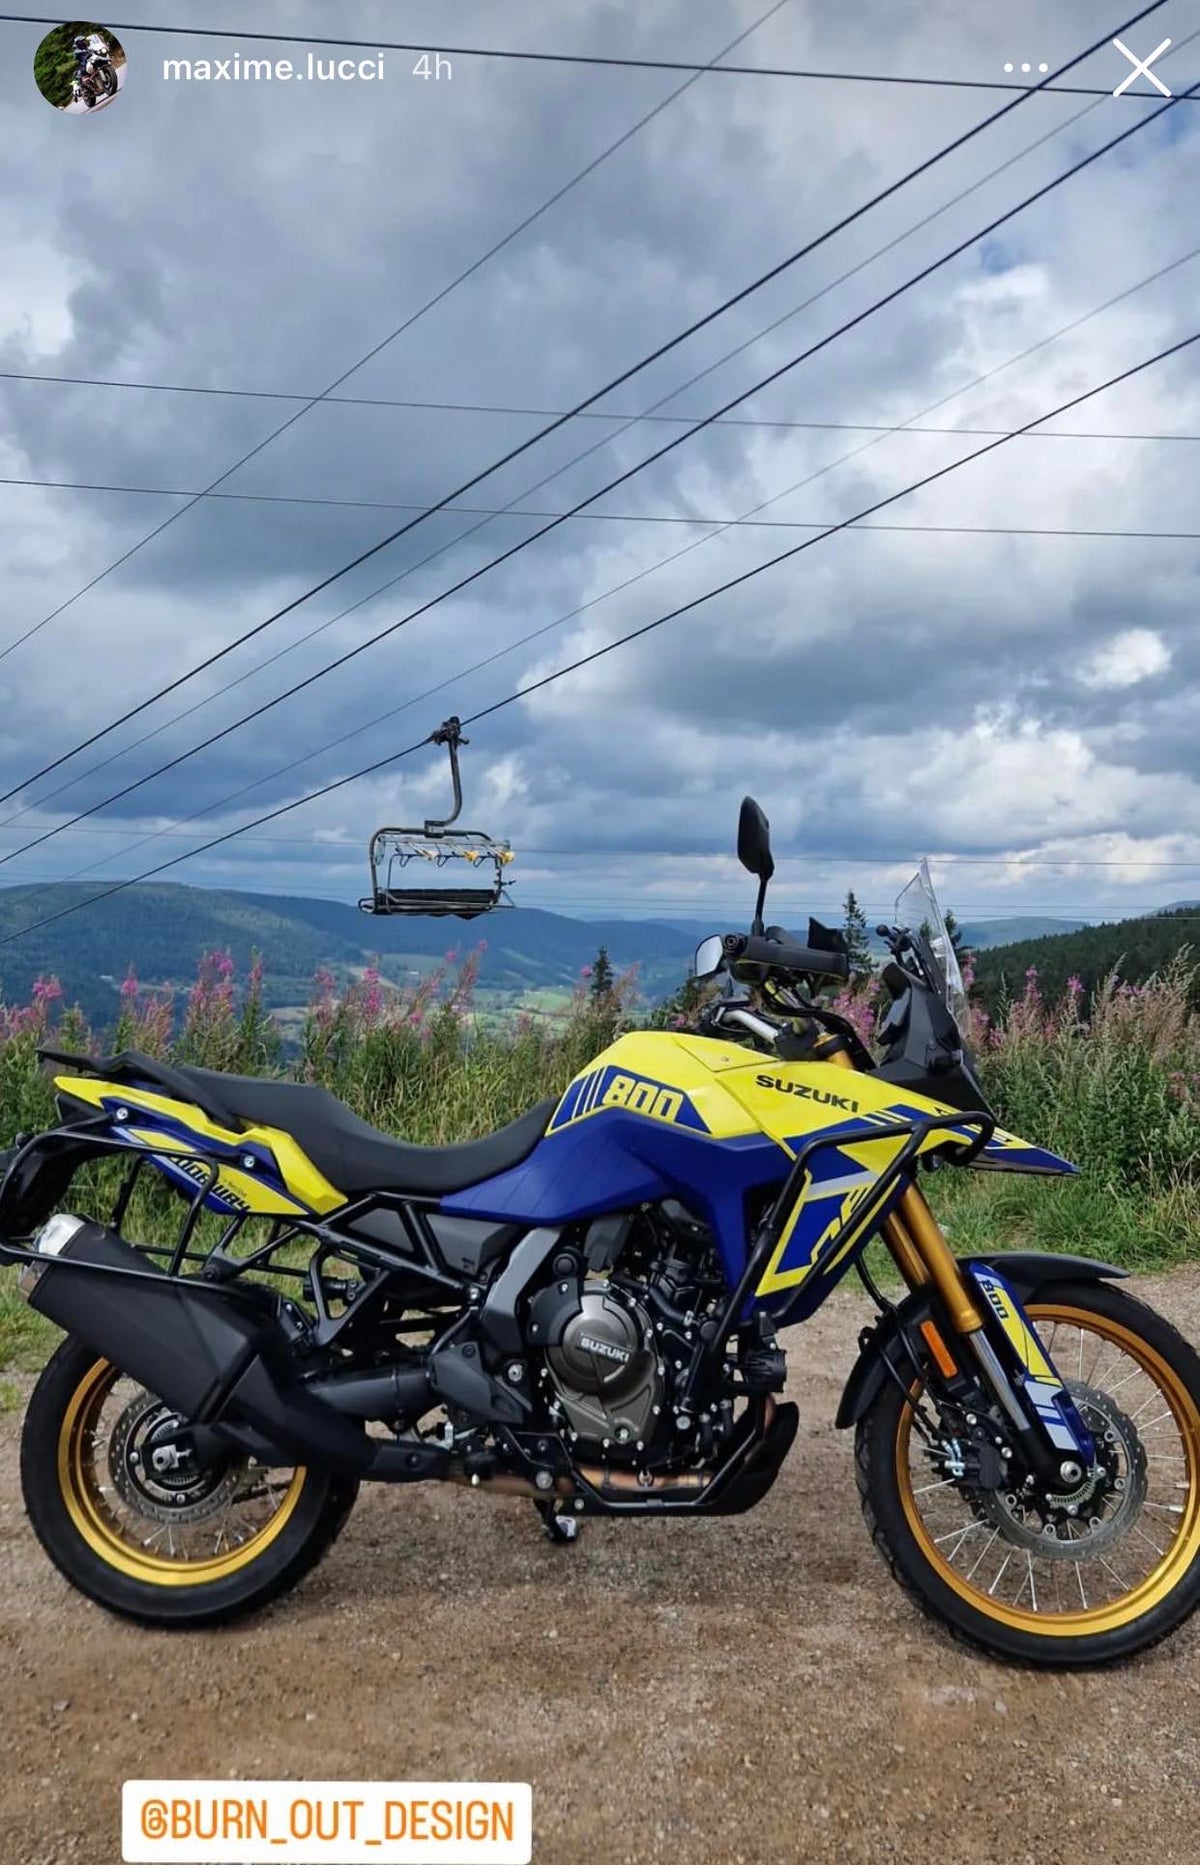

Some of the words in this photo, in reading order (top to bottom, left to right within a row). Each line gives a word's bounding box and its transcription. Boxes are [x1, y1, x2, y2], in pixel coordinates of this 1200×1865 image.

[602, 1074, 684, 1125] 800
[755, 1073, 859, 1114] SUZUKI
[980, 1279, 1010, 1319] 800
[580, 1336, 631, 1363] SUZUKI
